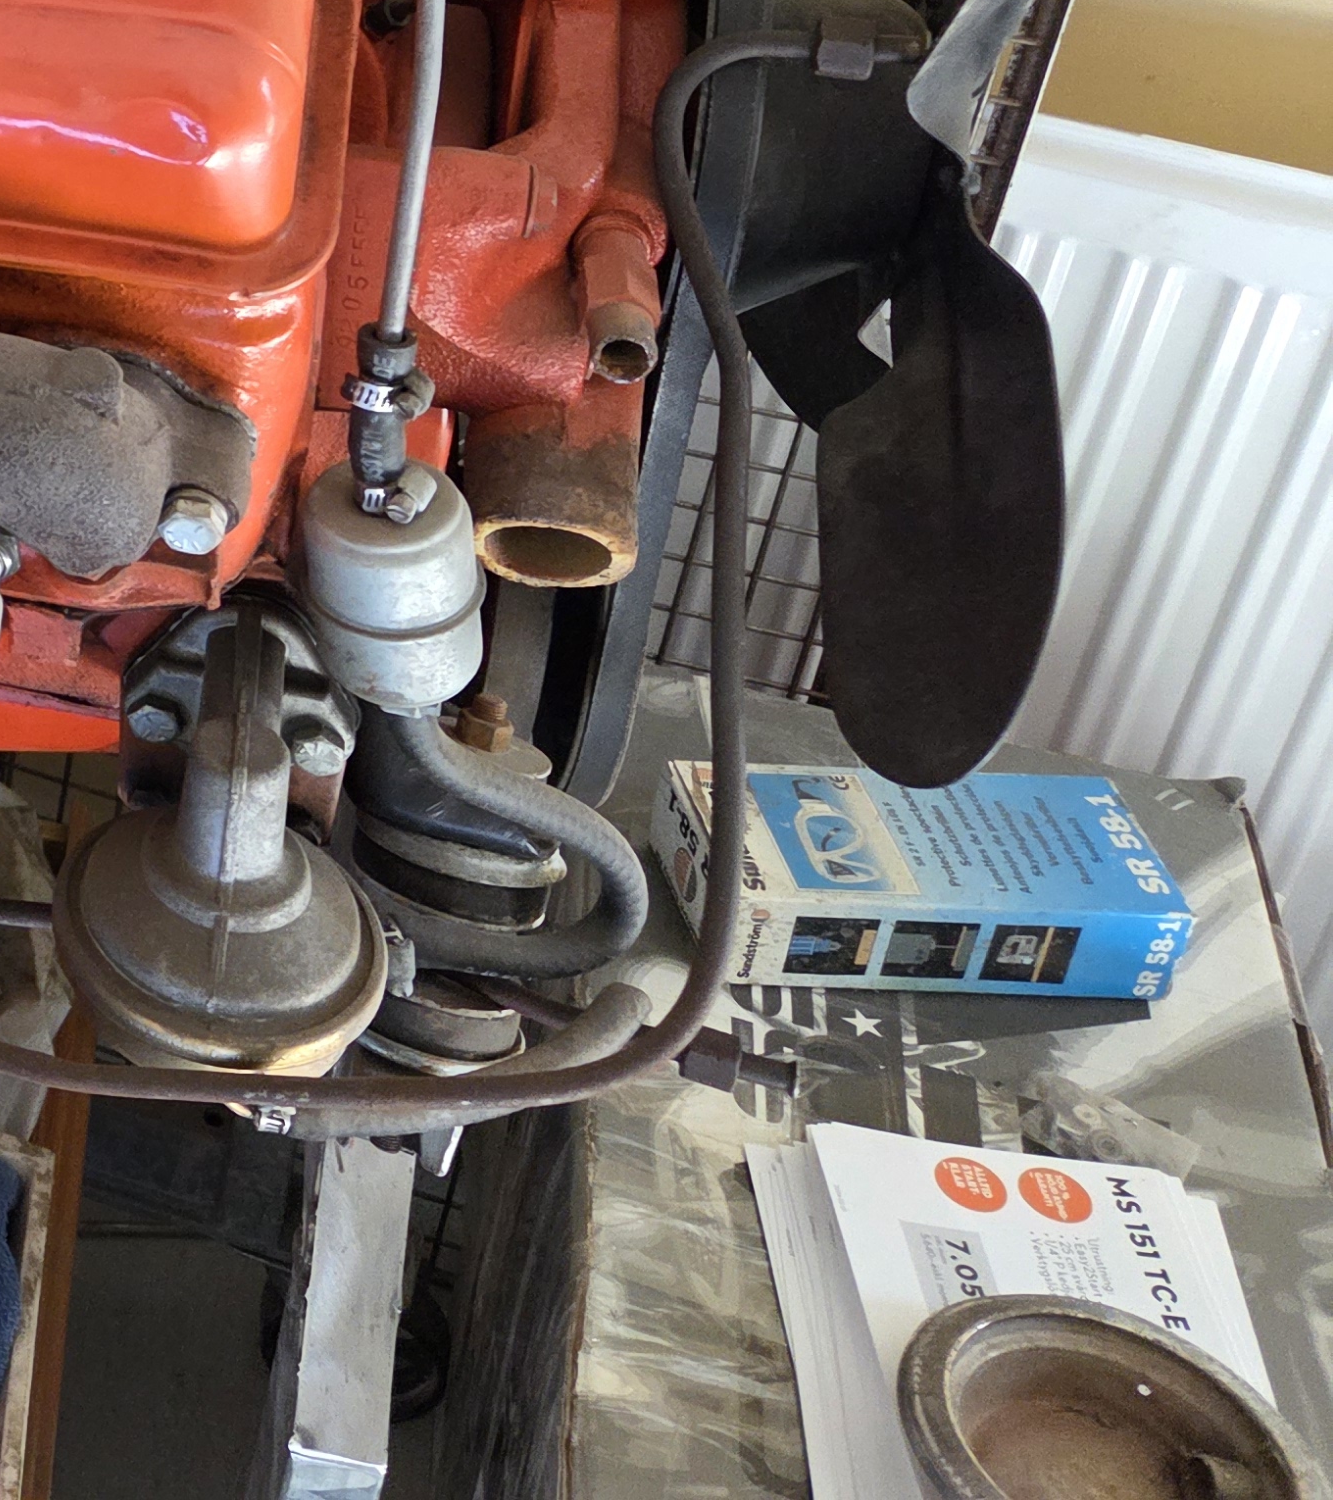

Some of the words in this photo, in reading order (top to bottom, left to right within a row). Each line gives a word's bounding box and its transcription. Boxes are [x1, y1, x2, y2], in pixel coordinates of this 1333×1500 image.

[668, 788, 699, 857] 58-1
[1083, 794, 1144, 850] 58-1
[926, 836, 962, 886] Protective
[978, 848, 1009, 892] Lunettes
[1001, 849, 1032, 894] Anteojos
[1124, 857, 1171, 894] SR
[737, 923, 762, 979] Sundström
[1144, 919, 1182, 964] 58-1
[1132, 971, 1164, 996] SR
[949, 1162, 966, 1188] KLAR
[972, 1166, 993, 1198] ALLTID
[1034, 1173, 1054, 1206] GARANTI
[1075, 1243, 1102, 1297] Easy2Start
[1105, 1177, 1141, 1213] MS
[1124, 1223, 1160, 1258] 151
[1144, 1269, 1191, 1331] TC-E
